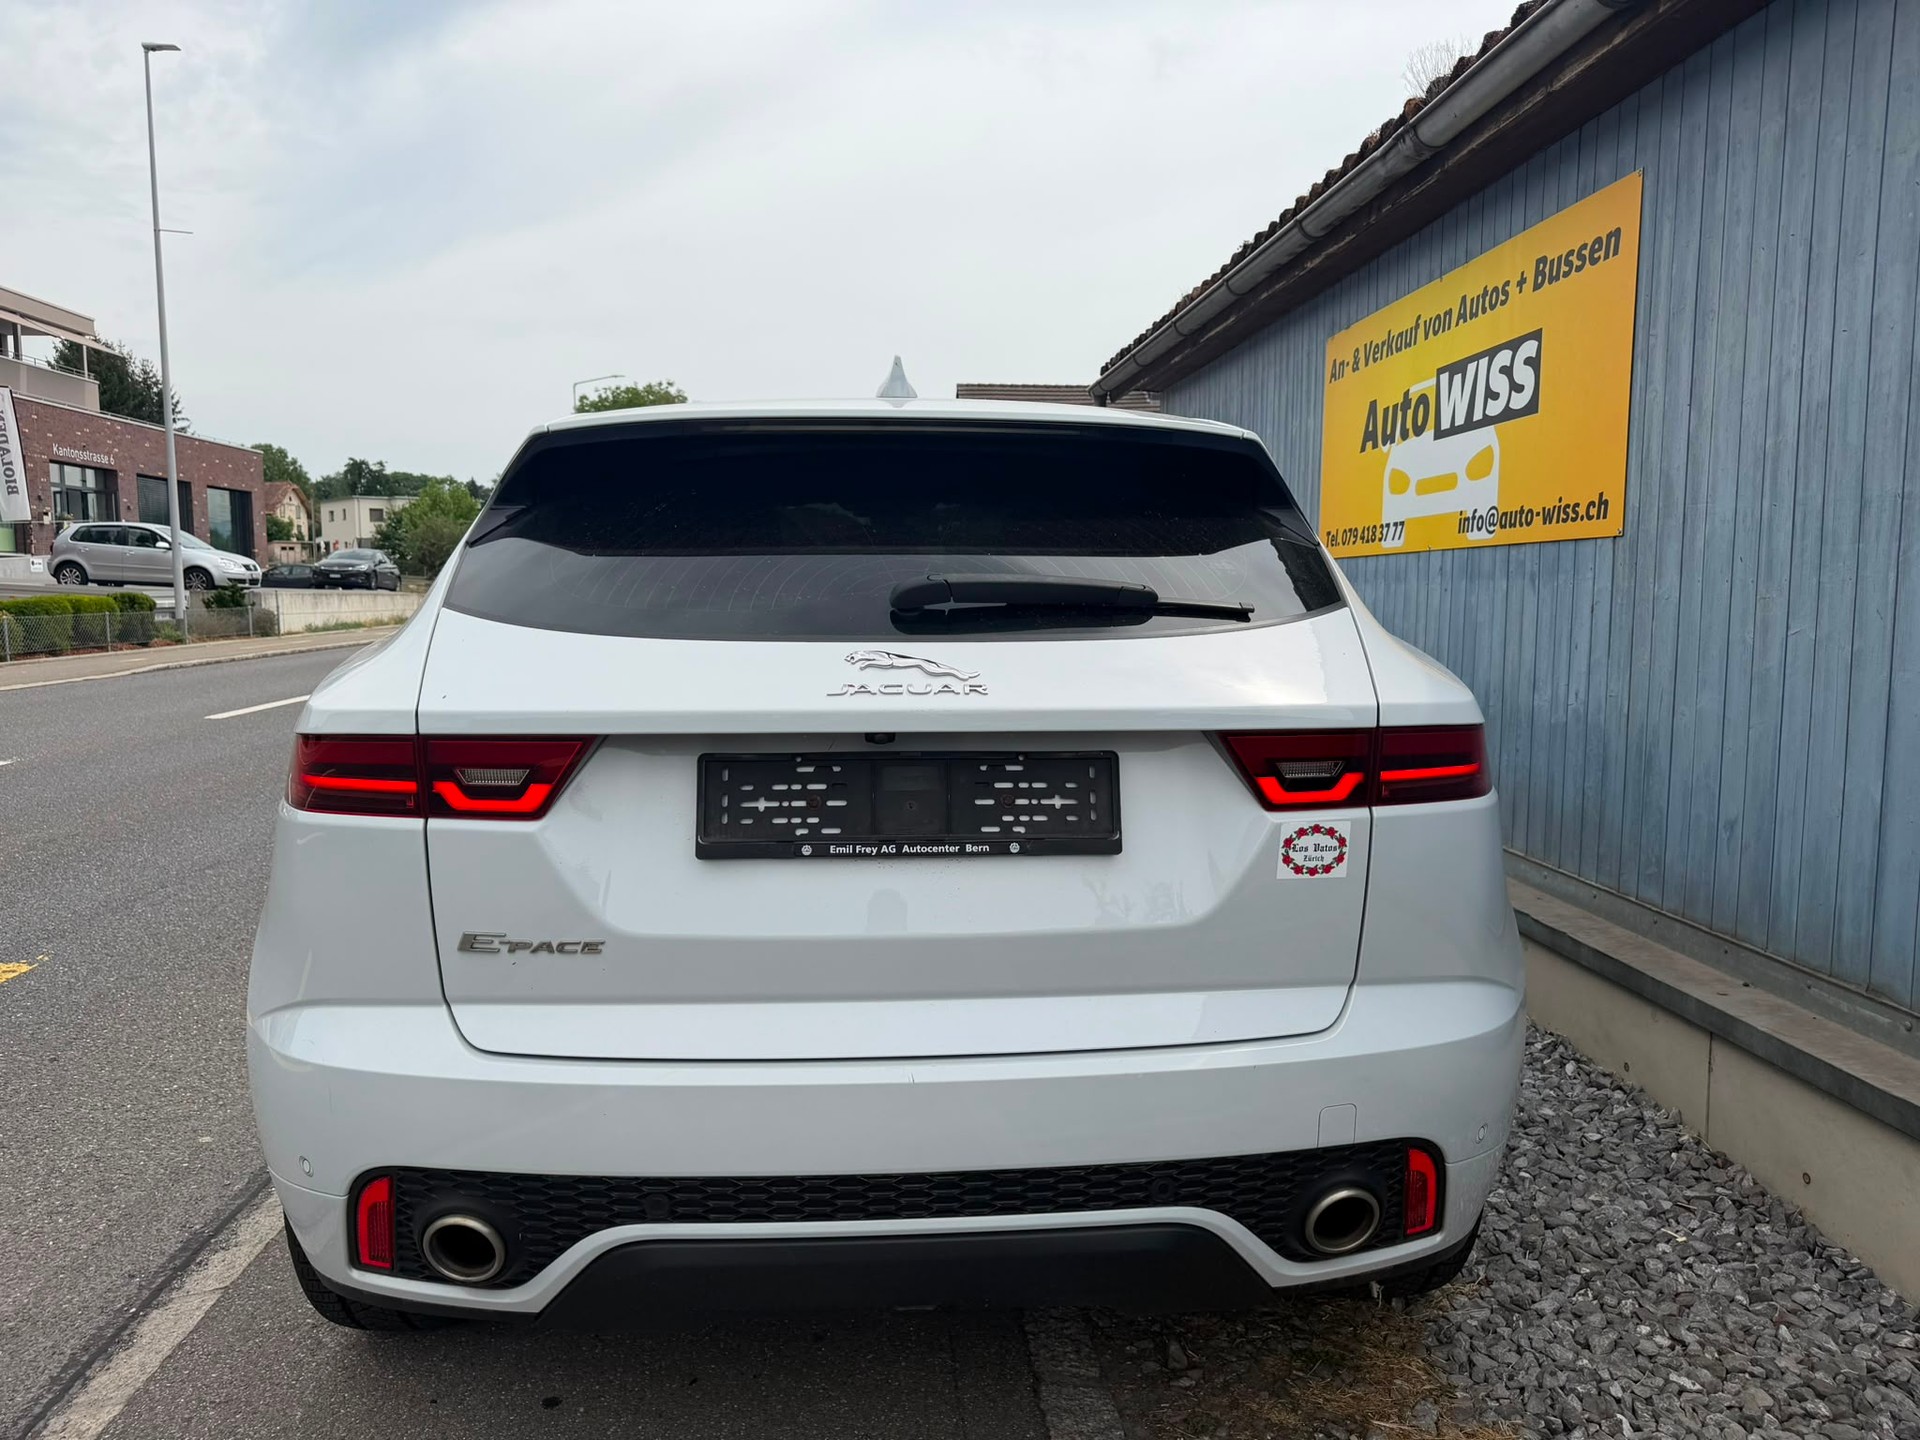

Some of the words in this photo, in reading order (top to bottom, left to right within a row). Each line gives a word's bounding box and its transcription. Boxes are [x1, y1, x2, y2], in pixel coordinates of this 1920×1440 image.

[1329, 358, 1350, 383] An-
[1351, 347, 1360, 372] &
[1363, 314, 1422, 368] Verkauf
[1423, 307, 1452, 341] von
[1454, 279, 1511, 328] Autos
[1515, 270, 1528, 294] +
[1532, 226, 1622, 292] Bussen
[1360, 388, 1430, 453] Auto
[1439, 339, 1539, 431] WISS
[52, 442, 109, 465] Kantonsstrasse
[109, 453, 115, 466] 6
[1457, 491, 1610, 535] info@auto-wiss.ch
[1325, 528, 1340, 548] Tel.
[1341, 526, 1359, 546] 079
[1359, 524, 1377, 544] 418
[1378, 521, 1391, 543] 37
[1391, 520, 1405, 541] 77
[826, 682, 989, 696] JAGUAR
[829, 845, 853, 854] Emil
[855, 845, 878, 856] Frey
[880, 844, 896, 854] AG
[902, 844, 960, 854] Autocenter
[965, 843, 990, 853] Bern
[1292, 843, 1309, 853] Los
[1313, 843, 1338, 853] Vatos
[1303, 854, 1325, 862] Zürich
